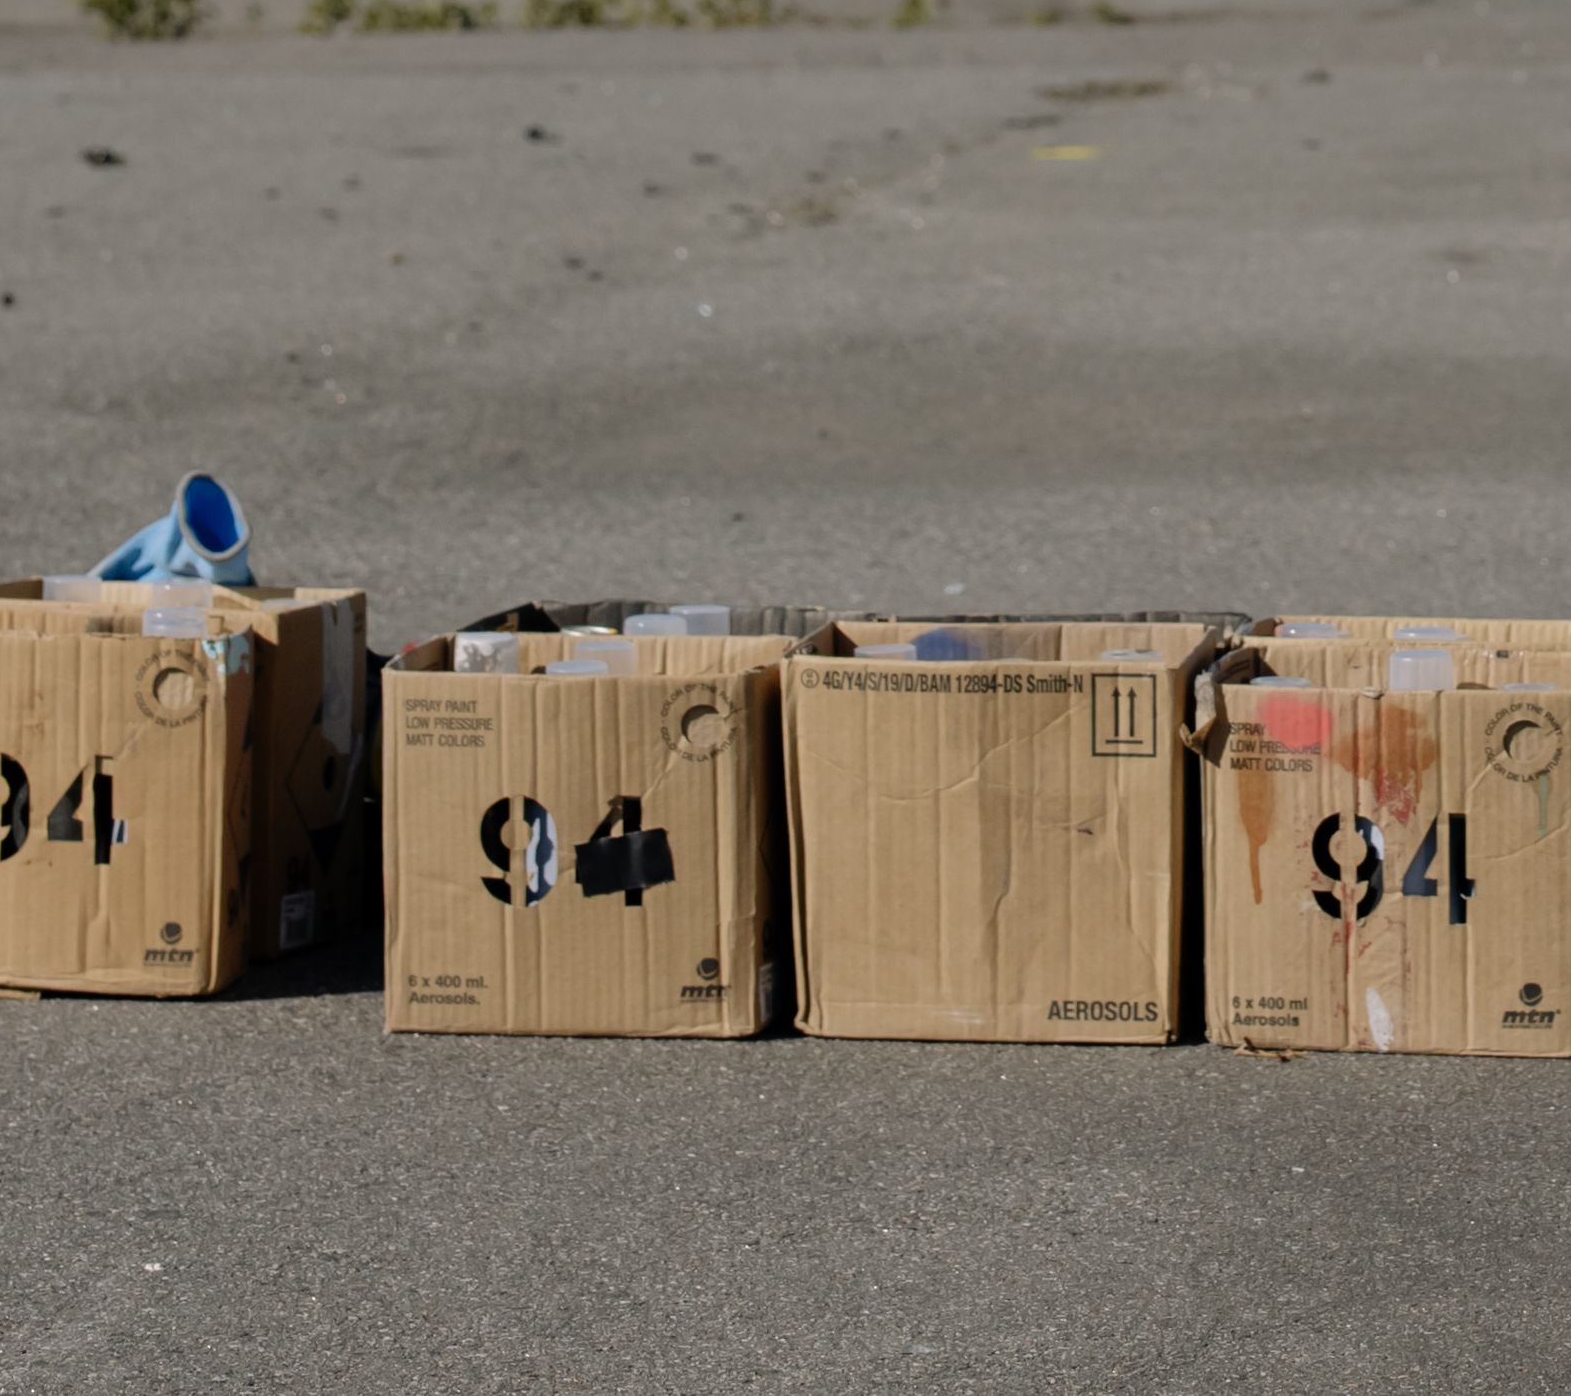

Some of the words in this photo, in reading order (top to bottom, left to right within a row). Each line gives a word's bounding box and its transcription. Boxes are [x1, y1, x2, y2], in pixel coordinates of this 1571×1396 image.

[955, 673, 1023, 694] 12894-DS
[1026, 673, 1084, 694] Smith-N
[405, 697, 442, 713] SPRAY
[445, 699, 477, 714] PAINT
[406, 716, 430, 729] LOW
[433, 716, 494, 731] PRESSURE
[405, 733, 434, 746] MATT
[438, 733, 486, 748] COLORS
[1230, 739, 1258, 753] LOW
[1230, 757, 1262, 771] MATT
[1265, 757, 1314, 773] COLORS
[480, 794, 667, 907] 94
[1311, 811, 1477, 925] 94
[408, 974, 418, 988] 6
[435, 974, 462, 989] 400
[1047, 1000, 1159, 1022] AEROSOLS
[1232, 995, 1241, 1009] 6
[1258, 996, 1286, 1011] 400
[1232, 1011, 1301, 1027] Aerosols
